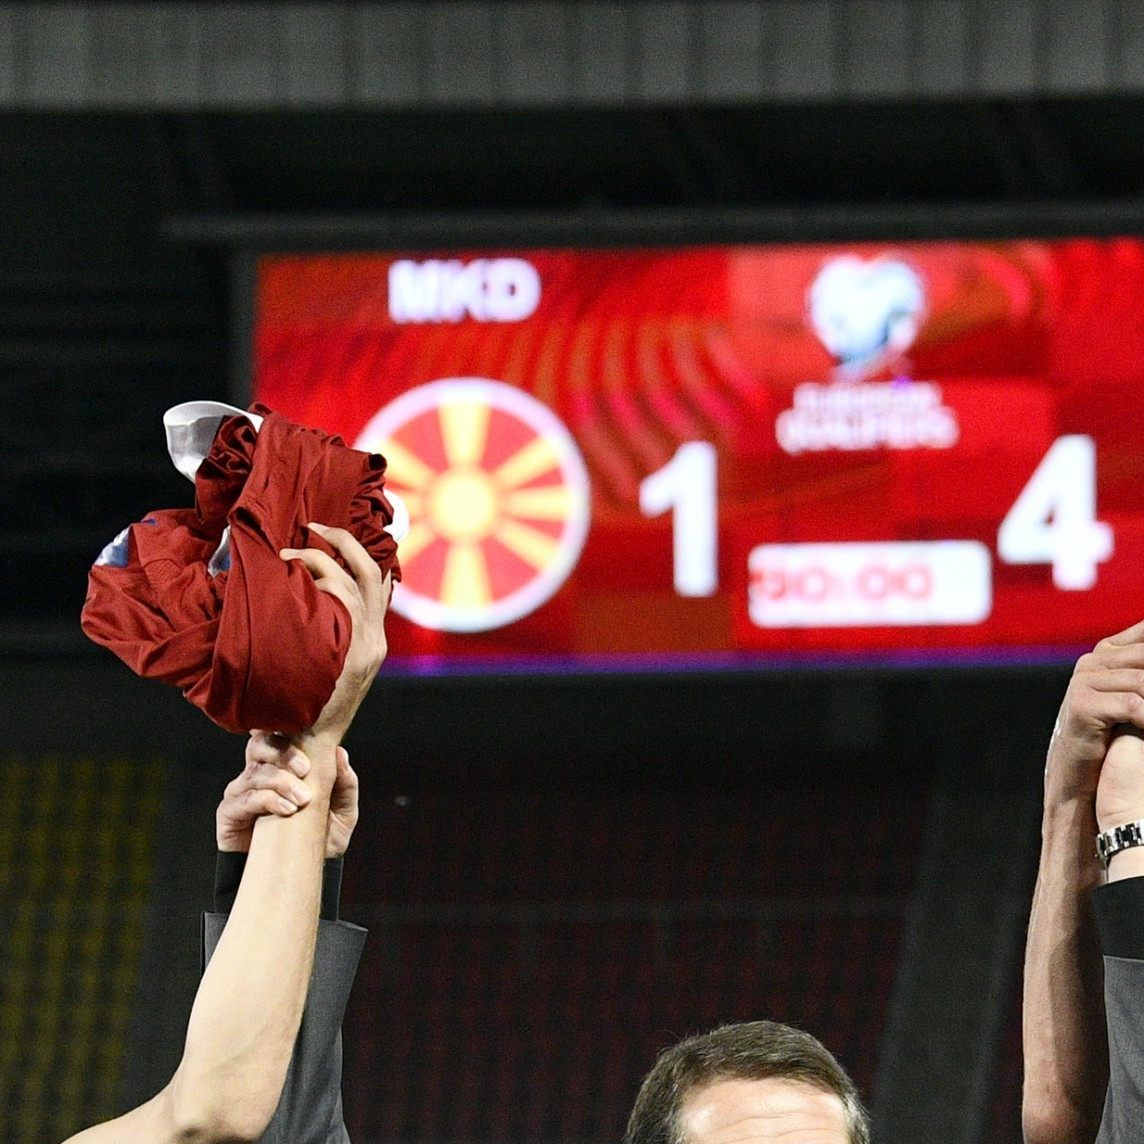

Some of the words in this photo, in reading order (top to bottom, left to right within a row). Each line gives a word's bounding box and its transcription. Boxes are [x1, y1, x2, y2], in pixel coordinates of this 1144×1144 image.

[388, 258, 542, 323] MKD
[641, 442, 718, 597] 1
[998, 434, 1113, 591] 4
